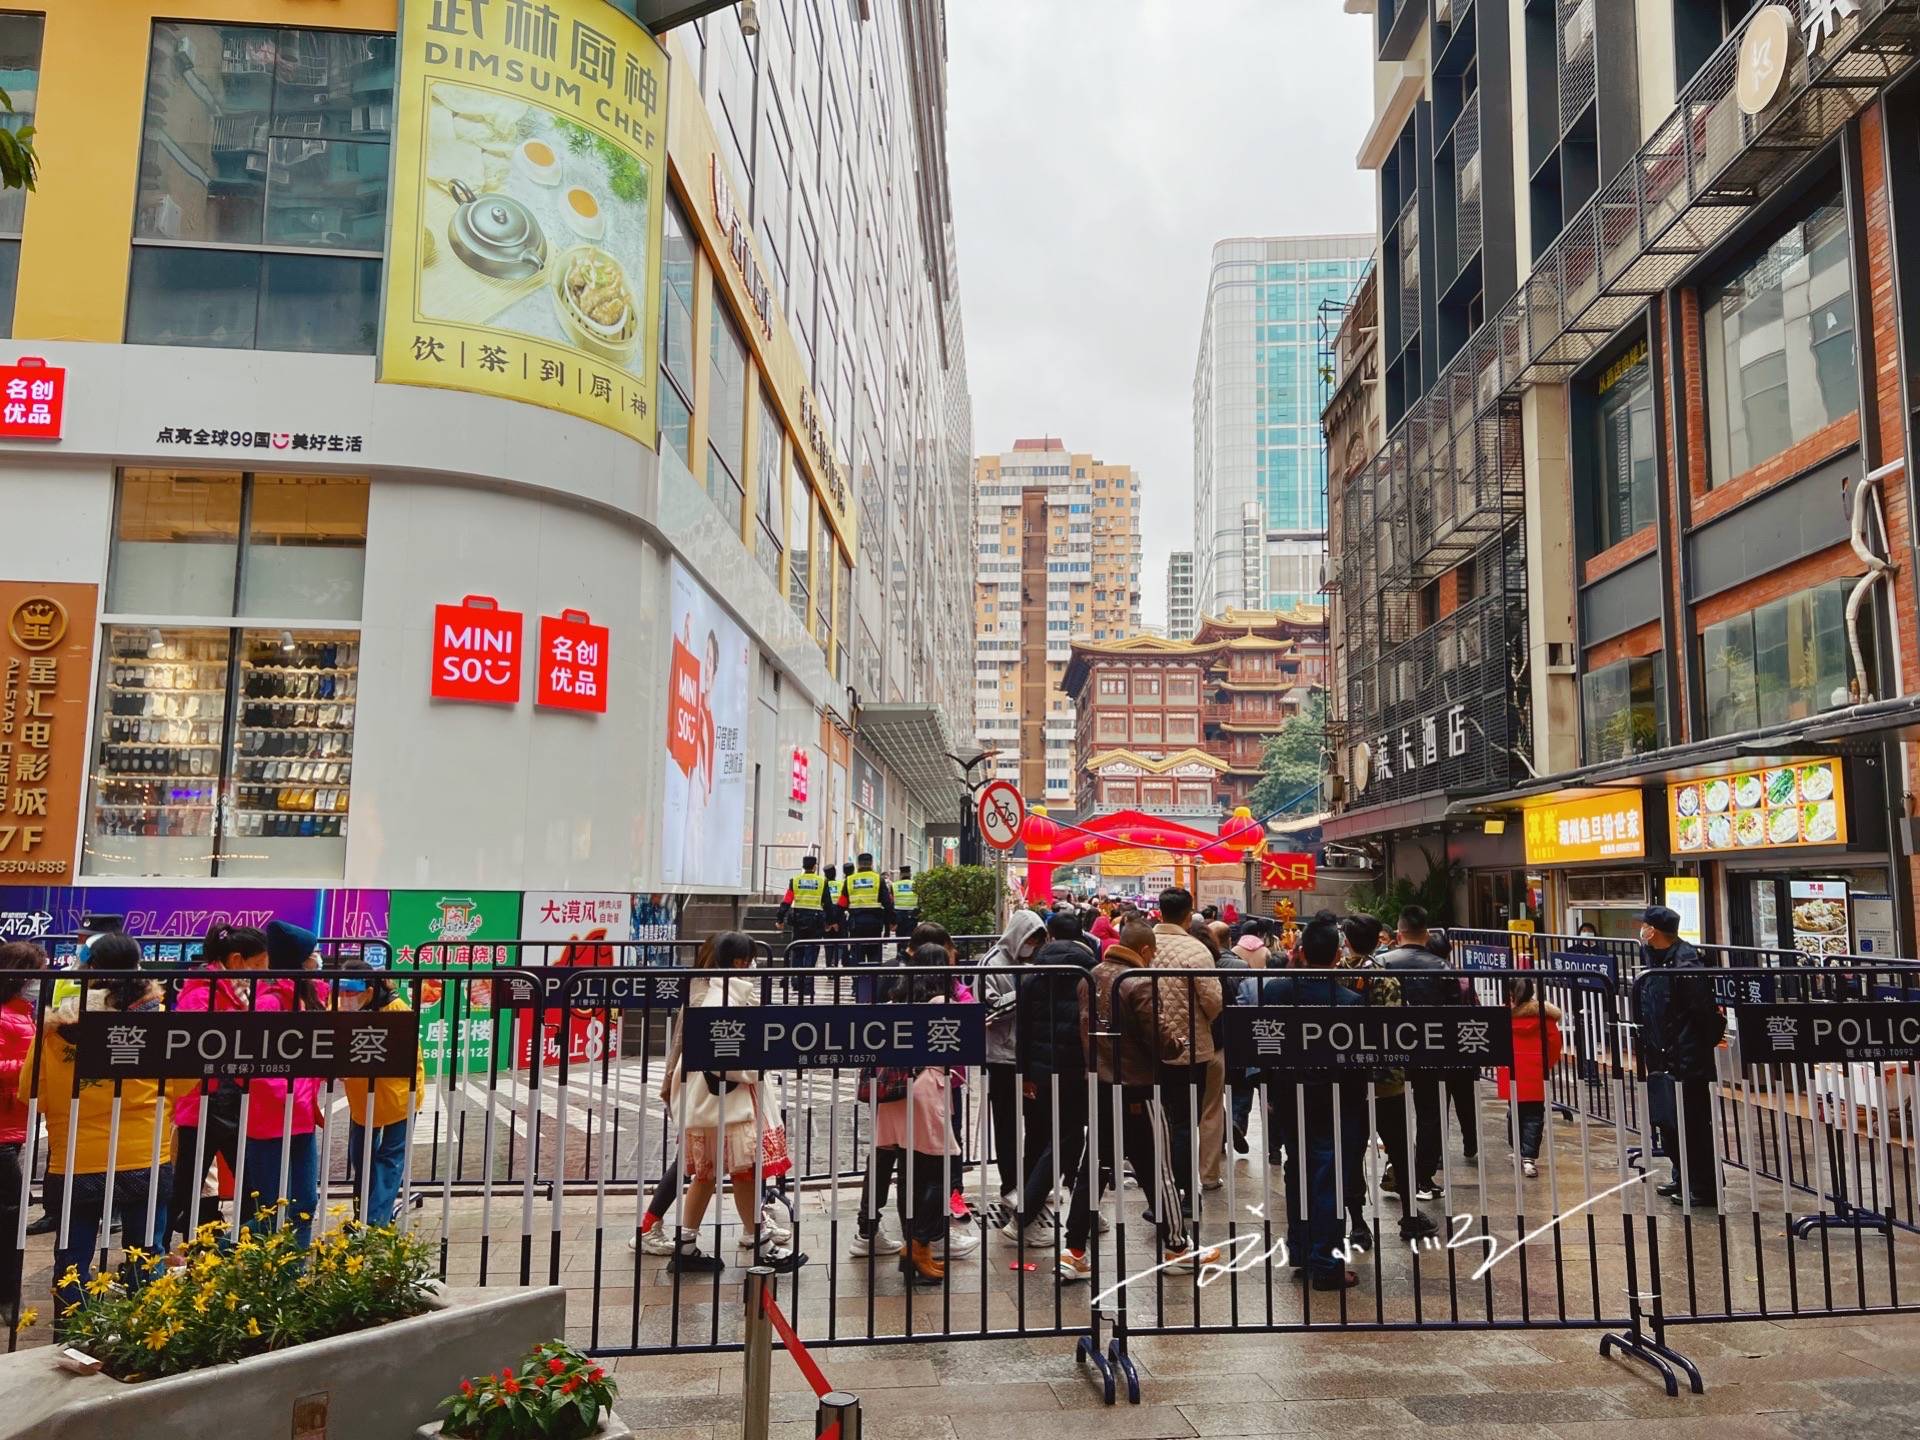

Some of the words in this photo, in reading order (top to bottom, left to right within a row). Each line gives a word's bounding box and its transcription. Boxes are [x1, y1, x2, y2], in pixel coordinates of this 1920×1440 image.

[427, 0, 658, 119] 武林厨神
[424, 41, 581, 106] DIMSUM
[595, 98, 655, 150] CHEF
[6, 378, 54, 401] 名创
[4, 402, 52, 426] 优品
[156, 426, 271, 449] 点亮全球99国
[292, 433, 363, 453] 美好生活
[443, 624, 513, 654] MINI
[551, 635, 599, 667] 名创
[2, 656, 20, 735] ALLSTAR
[550, 666, 598, 697] 优品
[678, 667, 697, 706] MINI
[11, 656, 57, 816] 星汇电影城
[1375, 704, 1467, 783] 莱卡酒店
[0, 826, 44, 852] 7F
[1265, 863, 1310, 882] 入口
[122, 911, 204, 938] PLAY
[540, 899, 598, 926] 大漠风
[1473, 951, 1499, 966] POLICE
[1499, 953, 1507, 968] 察
[1565, 961, 1597, 971] POLICE
[509, 977, 535, 1000] 警
[655, 976, 680, 1000] 察
[106, 1024, 148, 1066] 警
[165, 1028, 337, 1061] POLICE
[349, 1025, 389, 1064] 察
[709, 1018, 747, 1059] 警
[762, 1020, 915, 1052] POLICE
[926, 1015, 963, 1054] 察
[1252, 1018, 1286, 1056] 警
[1302, 1021, 1446, 1051] POLICE
[1456, 1019, 1491, 1054] 察
[1765, 1015, 1799, 1051] 警
[1812, 1017, 1920, 1046] POLIC
